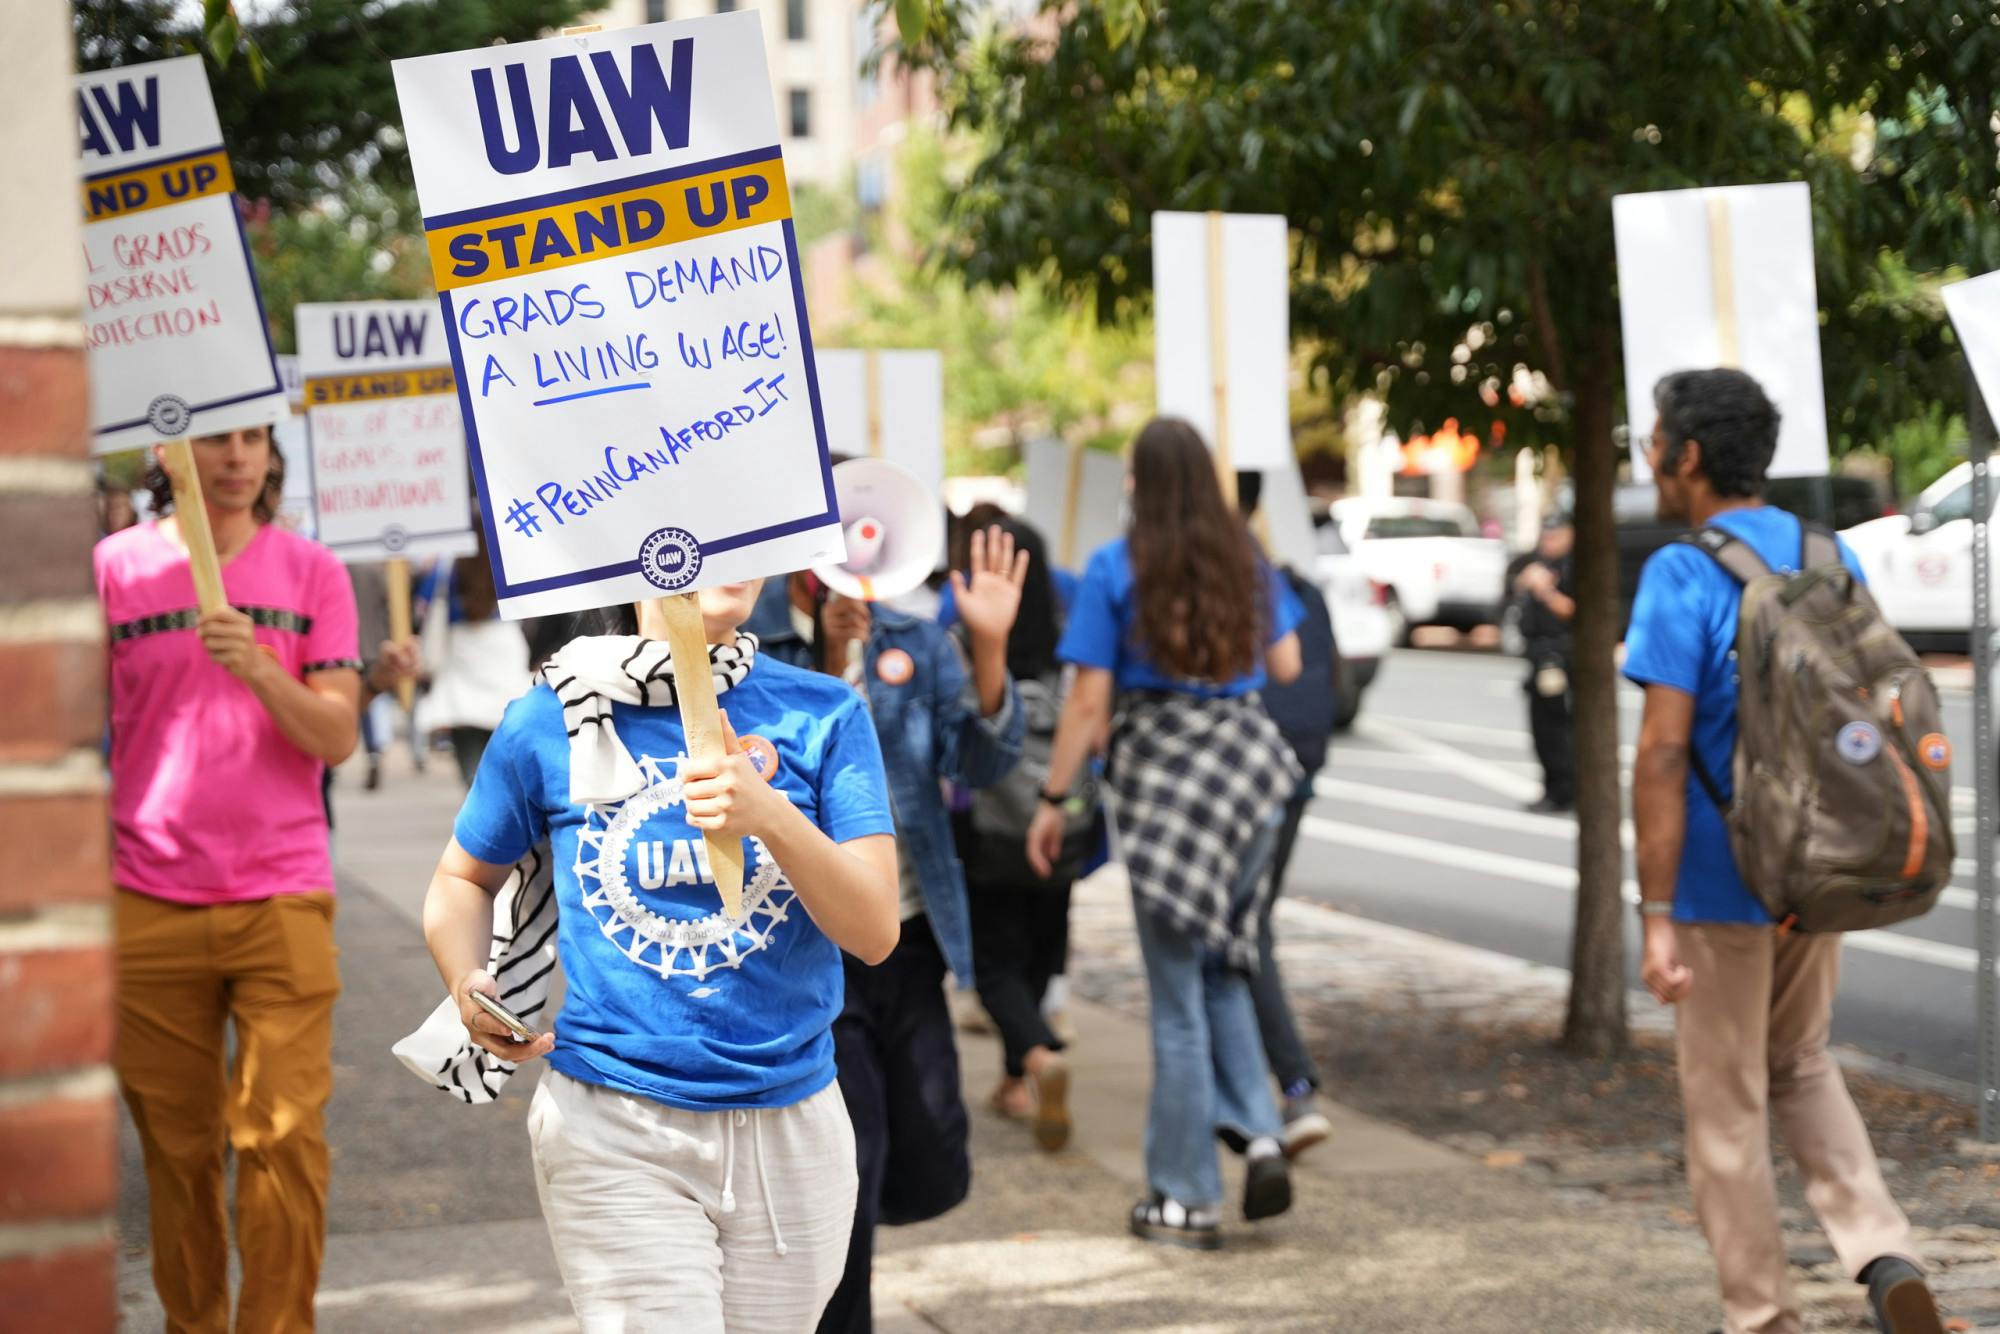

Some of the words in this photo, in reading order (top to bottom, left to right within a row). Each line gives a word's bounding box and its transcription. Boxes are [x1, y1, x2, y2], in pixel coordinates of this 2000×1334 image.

[78, 75, 160, 159] AW
[471, 37, 694, 175] UAW
[84, 179, 149, 217] ND
[160, 164, 218, 199] UP
[82, 241, 105, 273] L
[112, 221, 212, 270] GRADS
[448, 199, 666, 278] STAND
[684, 174, 770, 229] UP
[87, 265, 201, 310] DESERVE
[460, 283, 606, 339] GRADS
[625, 244, 783, 309] DEMAND
[82, 299, 222, 350] ROTECTION
[332, 311, 428, 359] UAW
[481, 353, 517, 397] A
[533, 333, 659, 388] LIVING
[677, 312, 788, 370] WAGE!
[313, 375, 409, 402] STAND
[657, 550, 682, 567] UAW
